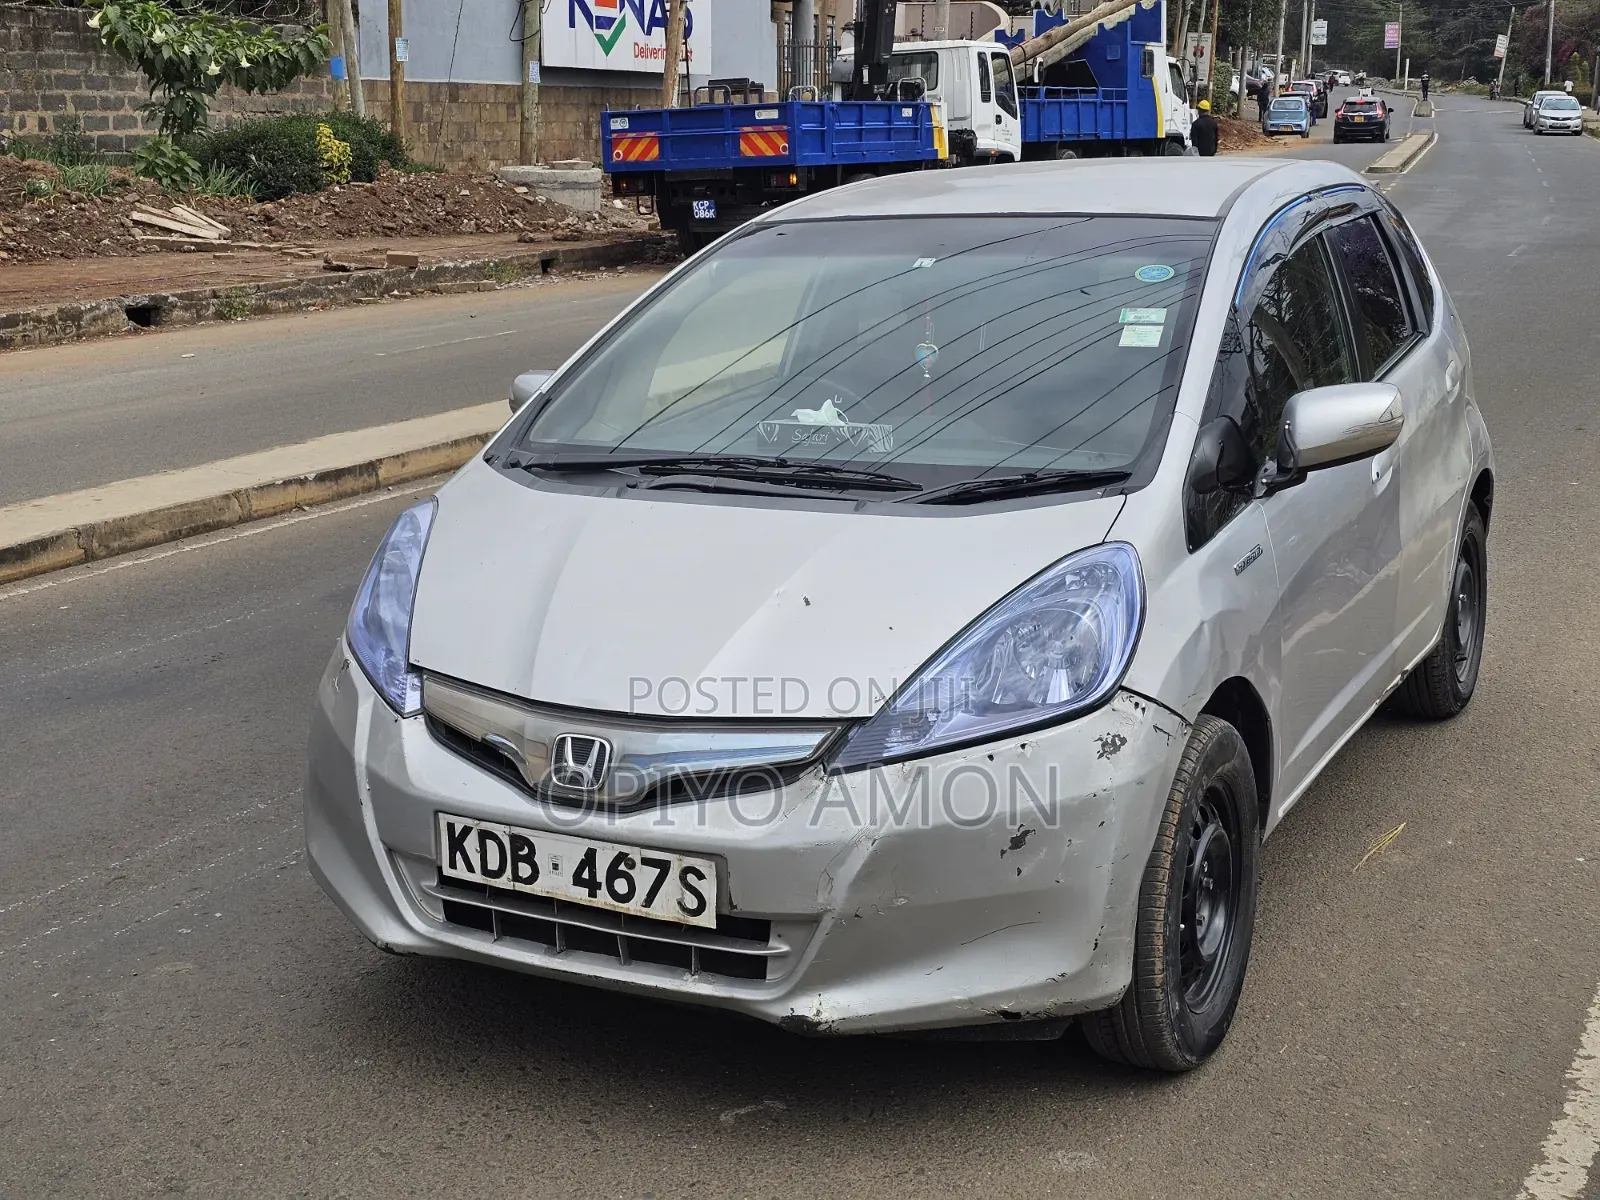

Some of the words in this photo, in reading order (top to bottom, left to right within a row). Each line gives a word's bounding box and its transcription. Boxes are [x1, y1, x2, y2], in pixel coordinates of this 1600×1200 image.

[633, 42, 668, 60] Deliverin
[693, 200, 709, 210] KCP
[694, 209, 715, 218] 086K
[792, 428, 829, 446] Safari
[446, 822, 540, 886] KDB
[572, 846, 708, 918] 467S
